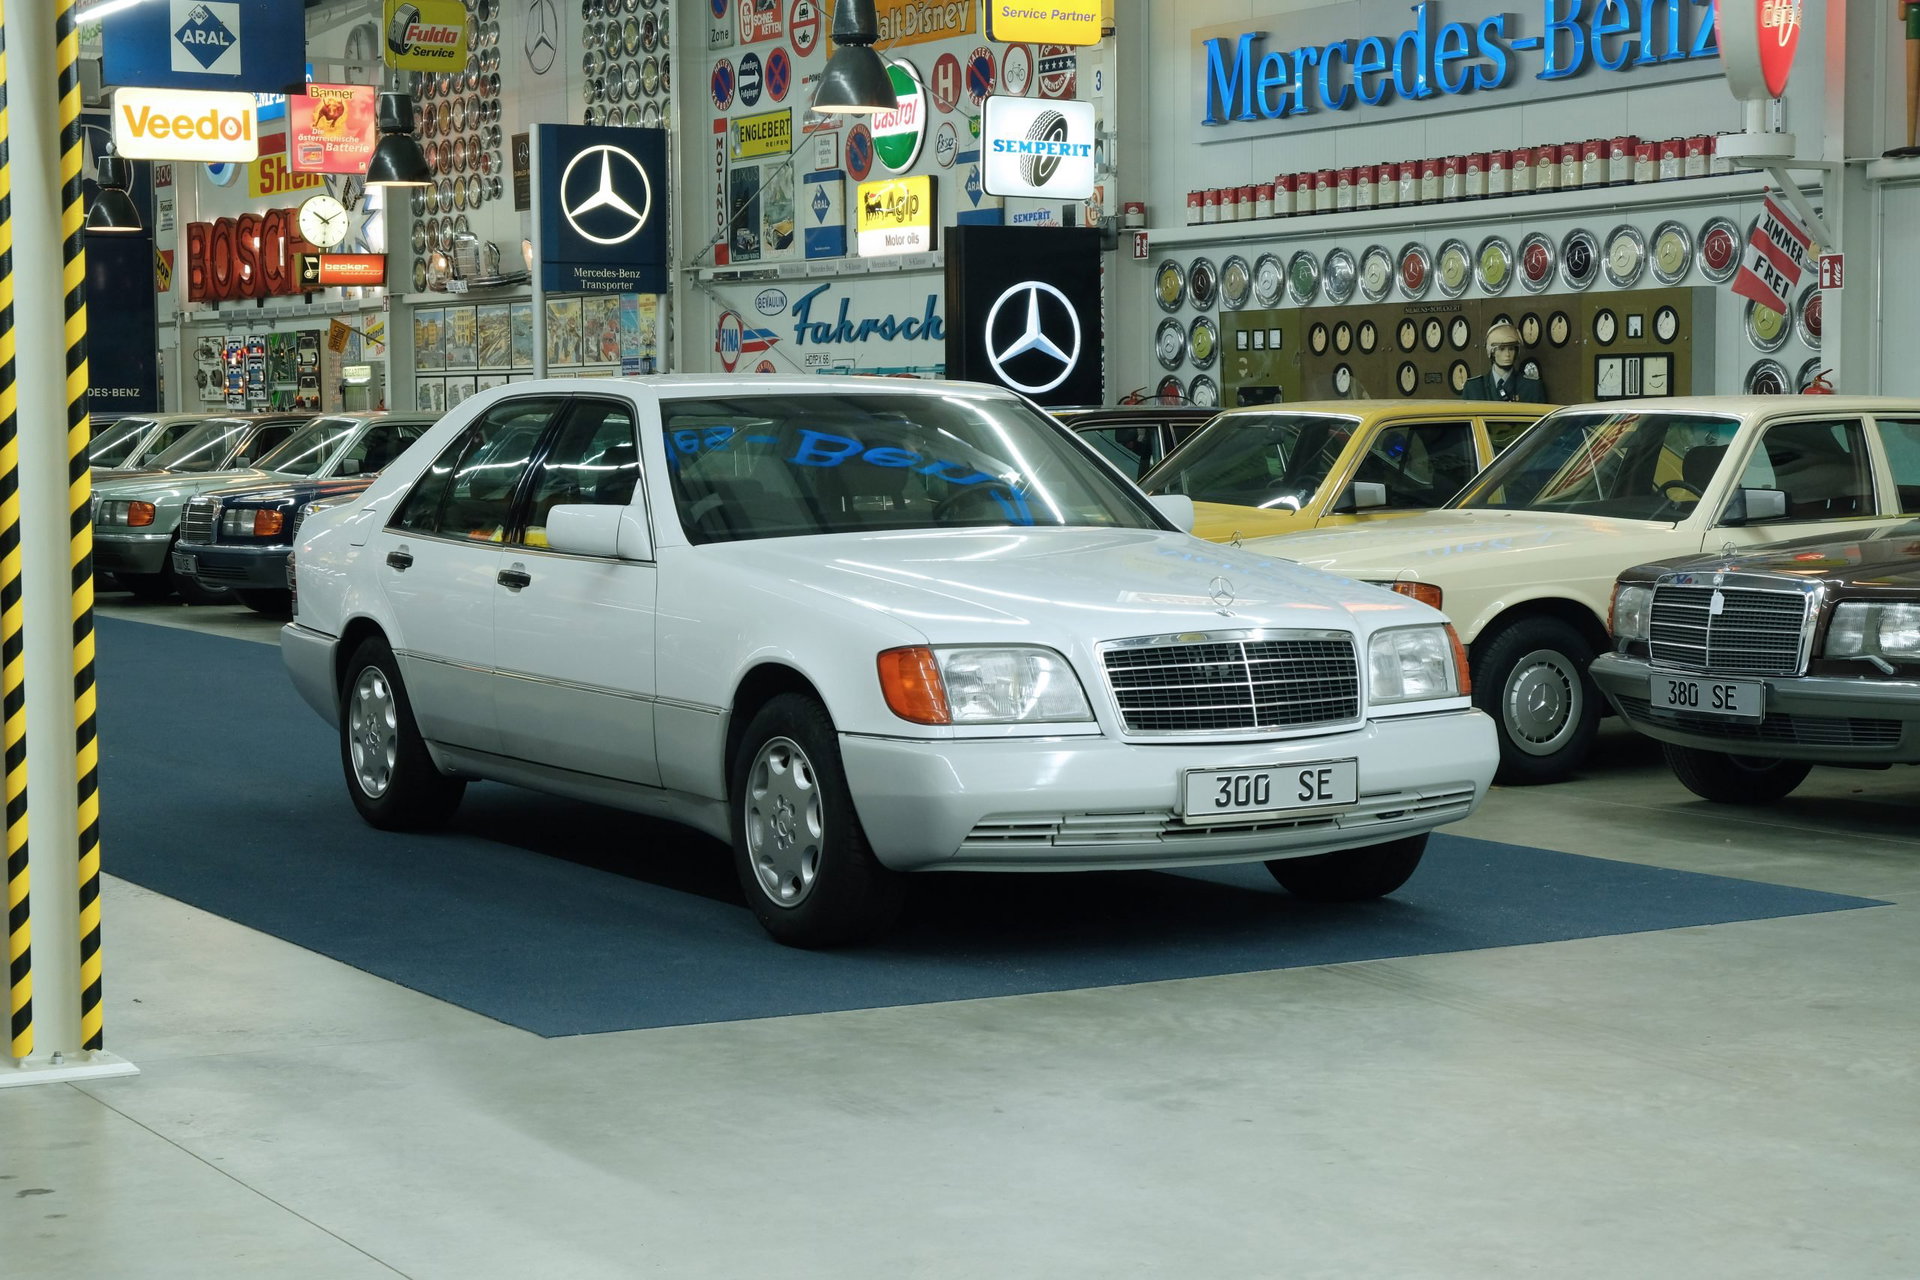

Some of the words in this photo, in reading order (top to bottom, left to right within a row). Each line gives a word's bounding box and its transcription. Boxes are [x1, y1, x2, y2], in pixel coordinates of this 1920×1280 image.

[753, 11, 773, 26] SCHNEE
[877, 8, 903, 41] alt
[905, 0, 969, 36] Disney
[1002, 6, 1047, 20] Service
[1051, 9, 1096, 22] Partner
[182, 29, 229, 46] ARAL
[407, 25, 457, 44] Fulda
[711, 29, 729, 42] Zone
[761, 22, 782, 35] KETTEN
[412, 46, 455, 58] Service
[1201, 0, 1718, 126] Mercedes-Benz
[938, 62, 953, 103] H
[1043, 74, 1065, 91] BENZIN
[1096, 70, 1101, 91] 3
[310, 87, 354, 100] Banner
[122, 105, 251, 141] Veedol
[873, 98, 918, 130] Castrol
[298, 132, 360, 143] österreichische
[739, 118, 790, 143] ENGLEBERT
[326, 142, 370, 153] Batterie
[765, 139, 789, 148] REIFEN
[992, 139, 1091, 157] SEMPERIT
[156, 165, 171, 183] 300
[886, 190, 919, 223] Agip
[1013, 211, 1051, 224] SEMPERIT
[885, 235, 905, 246] Motor
[907, 232, 920, 244] oils
[1763, 214, 1804, 266] ZIMMER
[325, 263, 369, 271] becker
[574, 267, 641, 279] Mercedes-Benz
[581, 279, 634, 291] Transporter
[1753, 254, 1790, 299] FREI
[792, 283, 945, 345] Fahrsch
[722, 328, 739, 353] FINA
[1668, 680, 1698, 707] 380
[1712, 684, 1737, 710] SE
[1215, 774, 1270, 808] 300
[1298, 768, 1333, 802] SE
